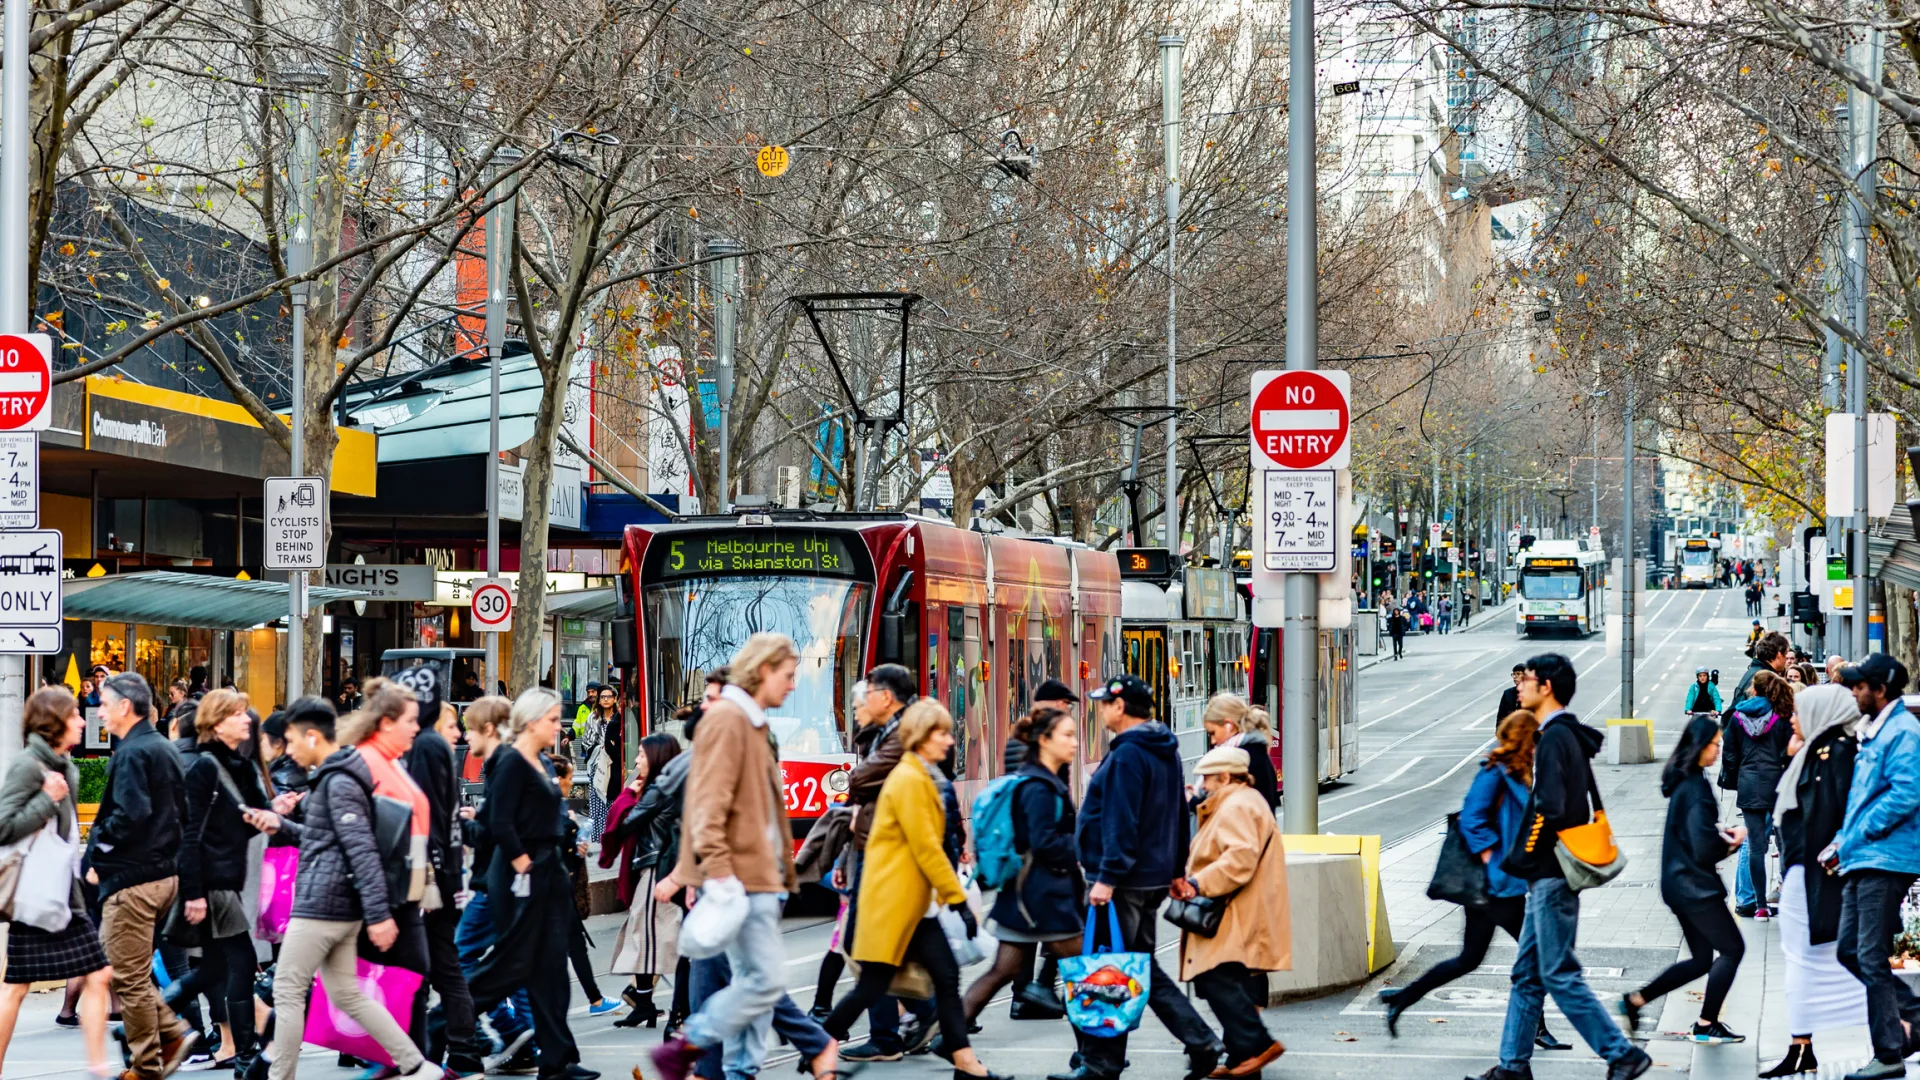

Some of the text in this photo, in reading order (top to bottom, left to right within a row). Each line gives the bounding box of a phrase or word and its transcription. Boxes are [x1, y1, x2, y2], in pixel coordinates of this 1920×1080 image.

[761, 151, 784, 161] CUT
[761, 162, 784, 172] OFF
[1285, 385, 1316, 405] NO
[1266, 435, 1334, 454] ENTRY
[10, 490, 28, 499] MID
[1274, 491, 1292, 500] MID
[270, 517, 319, 527] CYCLISTS
[282, 529, 307, 539] STOP
[1307, 531, 1325, 540] MID
[275, 542, 314, 552] BEHIND
[277, 554, 312, 564] TRAMS
[670, 539, 829, 570] 5 Melbourne Uni
[698, 554, 839, 570] via Swanston St
[1131, 554, 1147, 569] 3a
[1, 590, 53, 611] ONLY
[480, 595, 504, 613] 30
